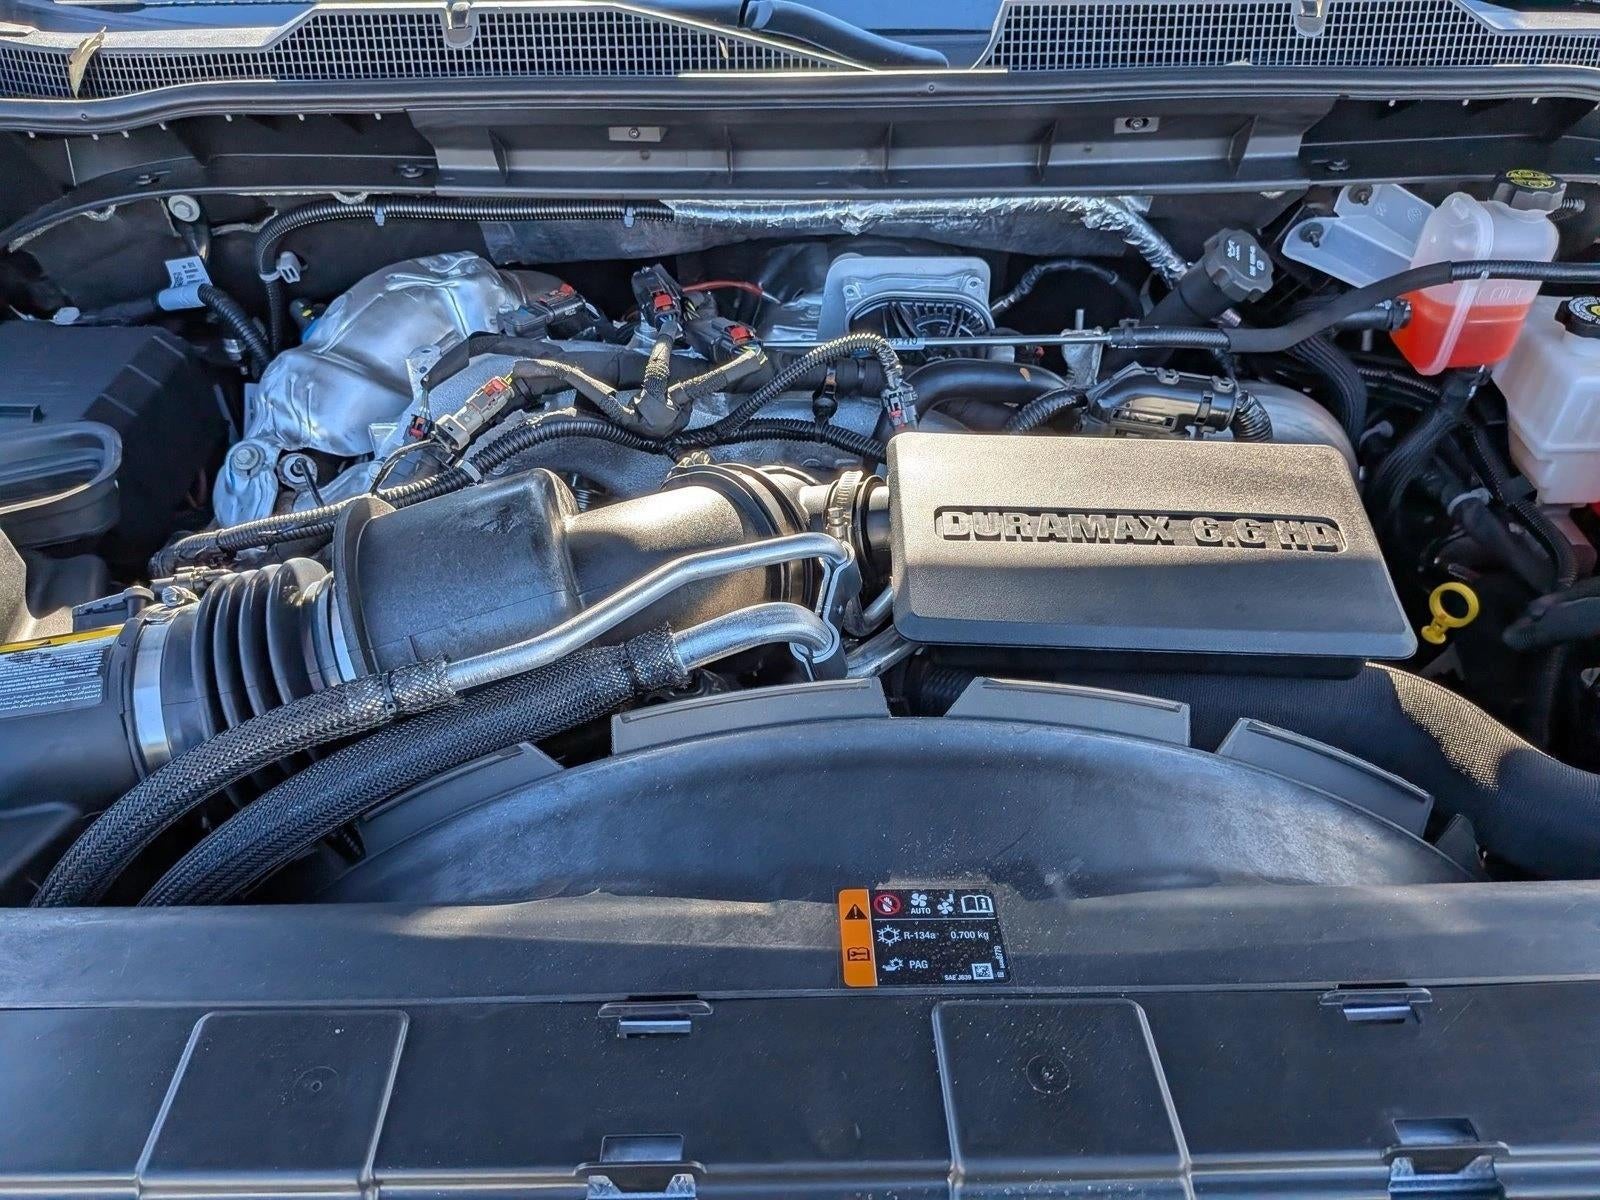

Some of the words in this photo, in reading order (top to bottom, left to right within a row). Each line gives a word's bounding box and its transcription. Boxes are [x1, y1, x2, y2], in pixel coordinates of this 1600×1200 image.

[941, 511, 1175, 545] DURAMAX
[1191, 516, 1267, 549] 6.6
[1279, 519, 1339, 552] HD
[910, 907, 931, 915] AUTO
[903, 931, 936, 939] R-134a
[950, 931, 975, 939] 0.700
[978, 931, 989, 941] kg
[909, 960, 929, 969] PAG
